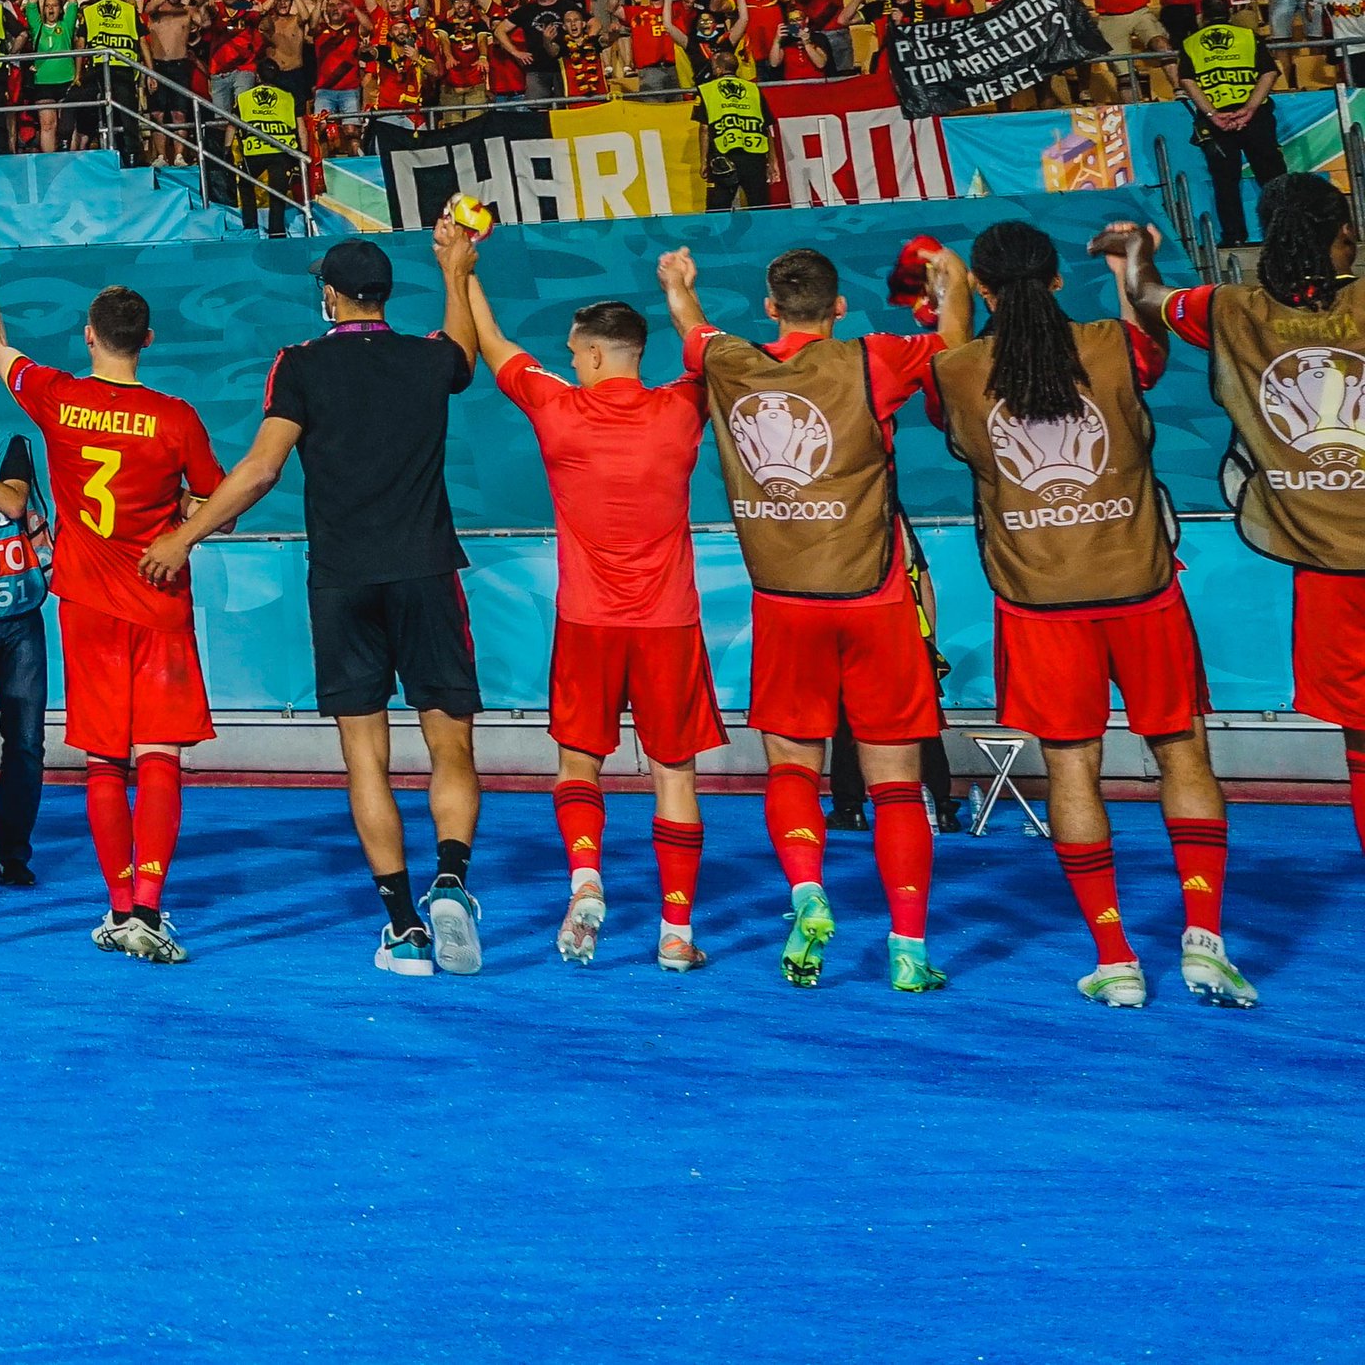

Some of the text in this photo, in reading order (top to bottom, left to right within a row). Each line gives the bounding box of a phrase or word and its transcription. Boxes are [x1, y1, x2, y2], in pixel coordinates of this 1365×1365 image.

[904, 59, 953, 86] TON
[1051, 12, 1073, 38] ?
[59, 403, 156, 438] VERMAELEN
[1311, 450, 1360, 465] UEFA
[1266, 469, 1365, 490] EURO2
[79, 446, 122, 539] 3
[765, 484, 799, 498] UEFA
[1042, 484, 1083, 502] UEFA
[733, 499, 846, 520] EURO2020
[1003, 496, 1134, 531] EURO2020
